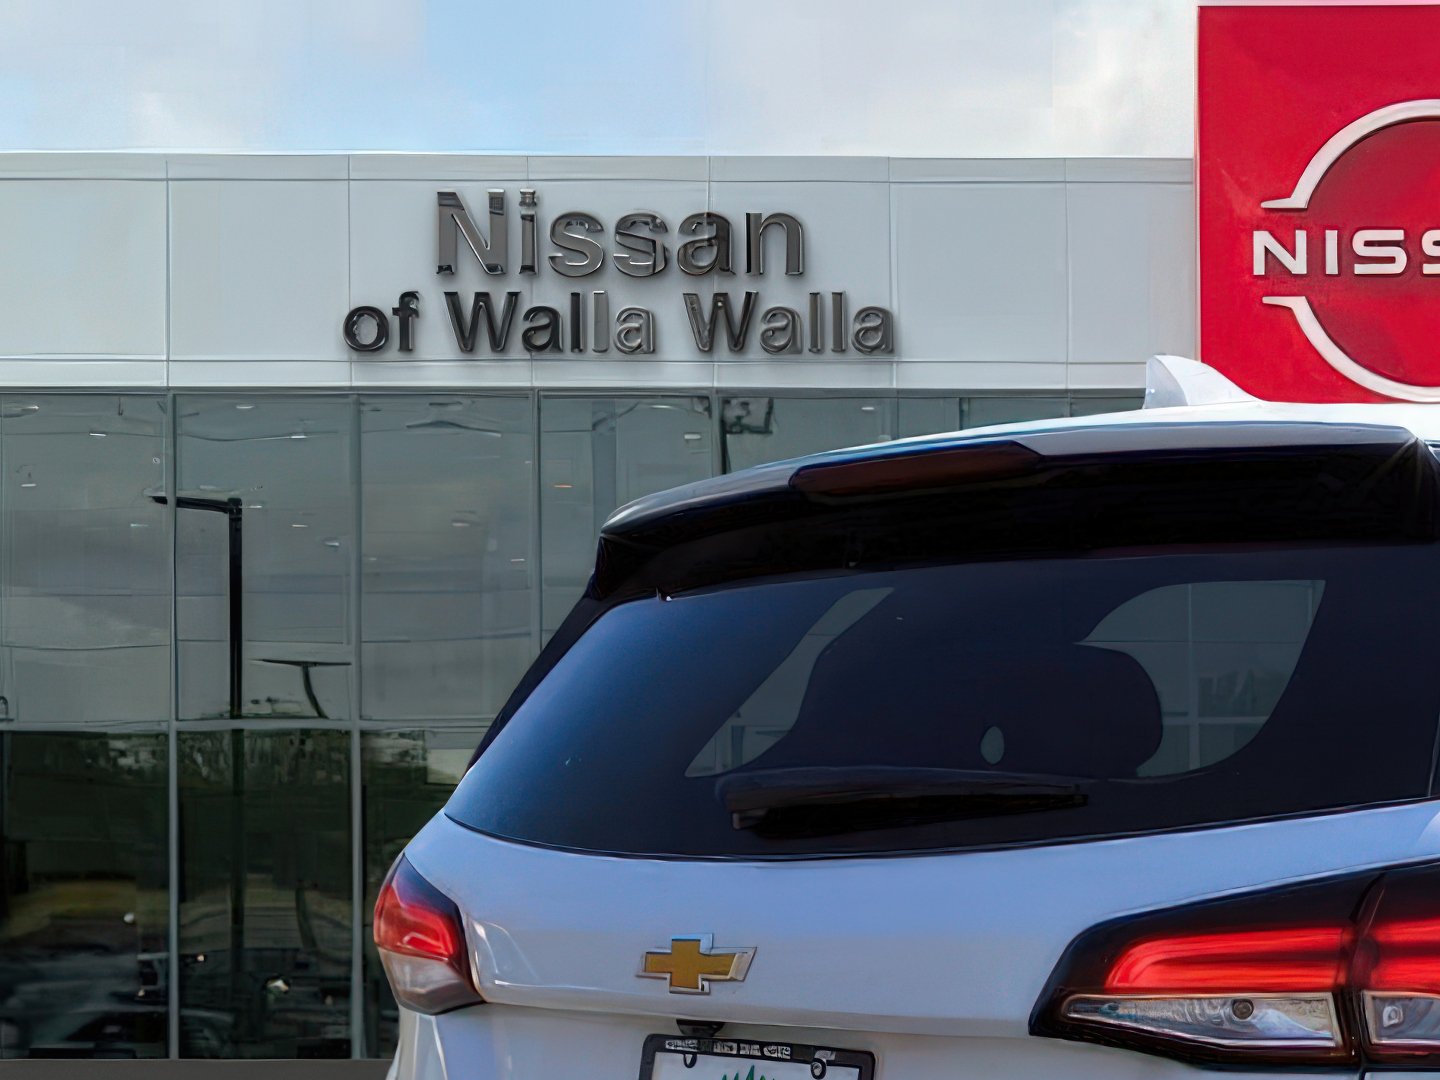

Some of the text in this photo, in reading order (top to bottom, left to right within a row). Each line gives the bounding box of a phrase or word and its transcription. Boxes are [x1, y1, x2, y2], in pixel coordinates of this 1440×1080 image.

[436, 189, 804, 277] Nissan
[343, 290, 894, 354] of Walla Walla
